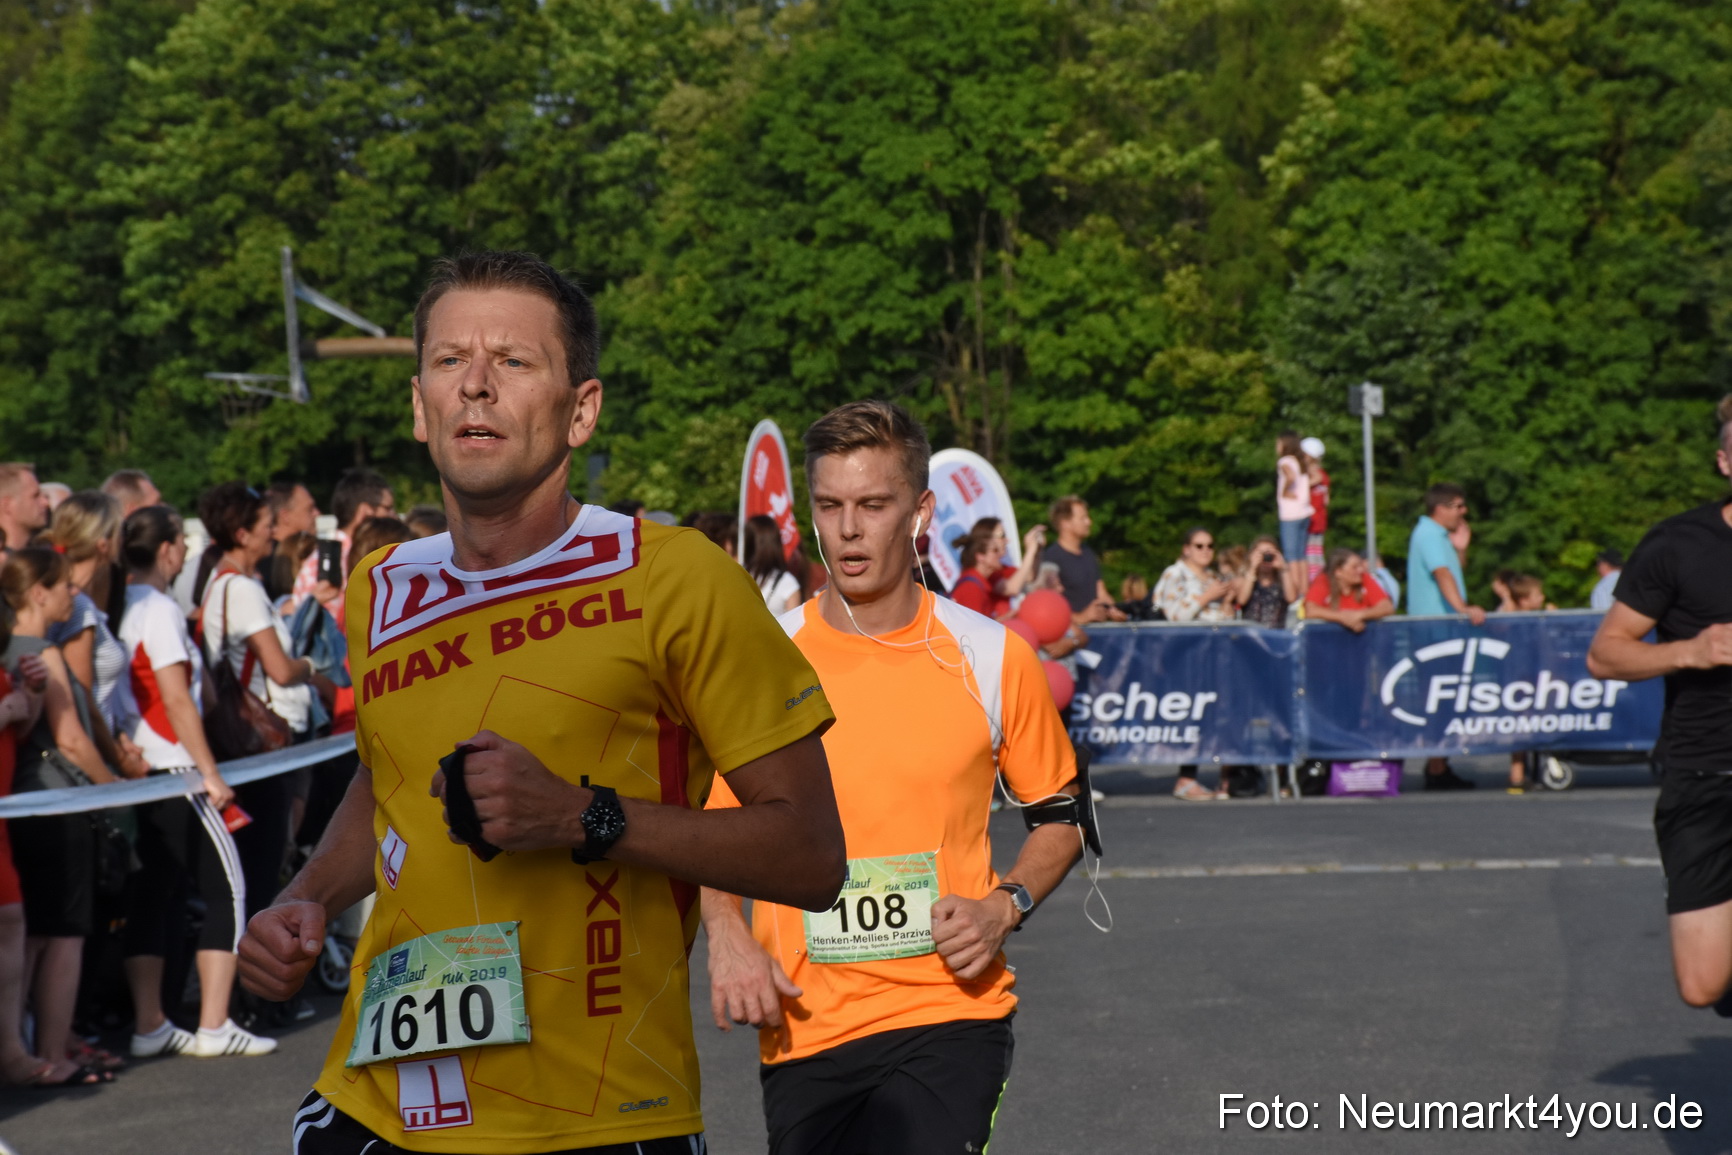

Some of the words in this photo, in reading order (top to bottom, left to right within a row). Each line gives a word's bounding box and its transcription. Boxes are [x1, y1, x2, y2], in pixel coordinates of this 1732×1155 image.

[362, 633, 473, 705] MAX
[490, 588, 643, 656] BÖGL
[1070, 681, 1218, 722] scher
[1425, 669, 1628, 714] Fischer
[1069, 725, 1200, 744] TOMOBILE
[1444, 711, 1613, 736] AUTOMOBILE
[842, 877, 872, 890] nlauf
[904, 880, 929, 890] 2019
[831, 893, 908, 933] 108
[585, 867, 623, 1018] max
[812, 933, 890, 946] Henken-Mellies
[892, 928, 932, 941] Parziva
[470, 966, 507, 981] 2019
[370, 984, 495, 1056] 1610
